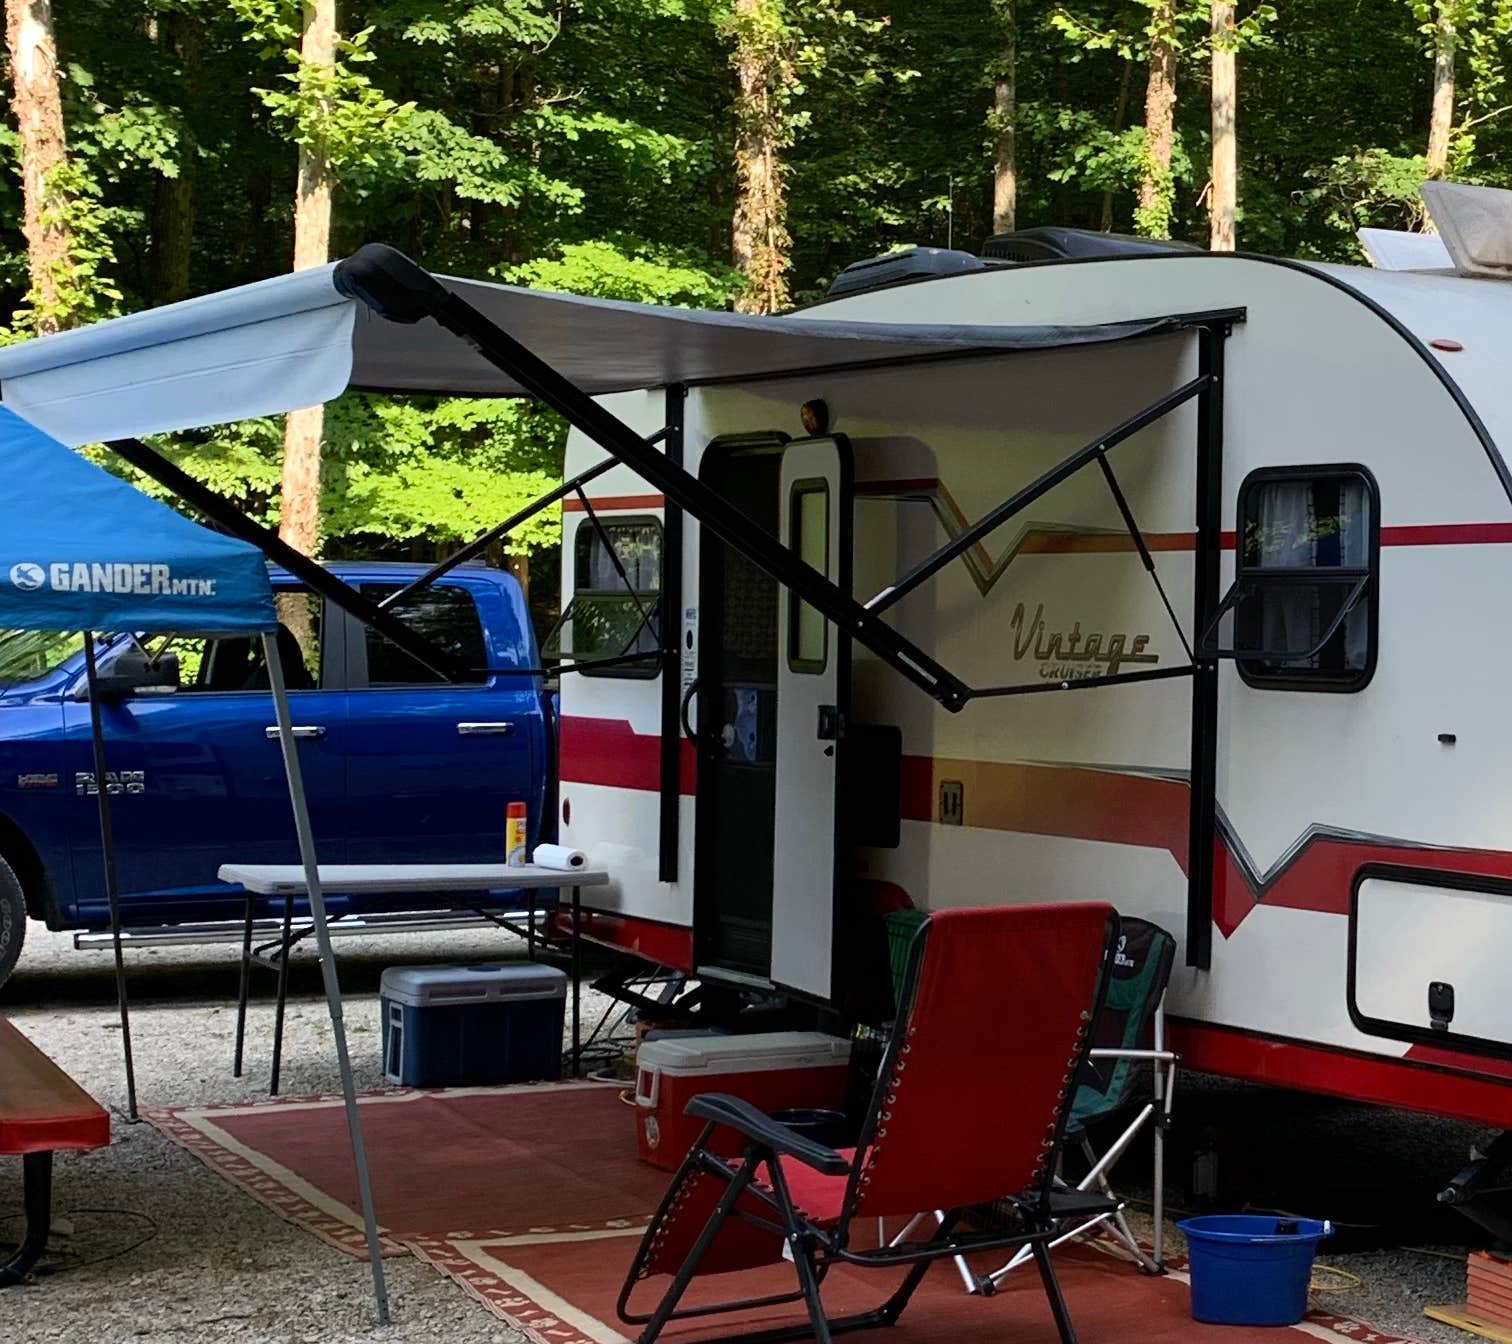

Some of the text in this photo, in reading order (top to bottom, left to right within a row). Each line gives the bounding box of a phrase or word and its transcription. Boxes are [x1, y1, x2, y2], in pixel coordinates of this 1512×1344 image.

[50, 563, 171, 594] GANDER
[1010, 602, 1158, 675] Vintage
[75, 771, 144, 783] RAM
